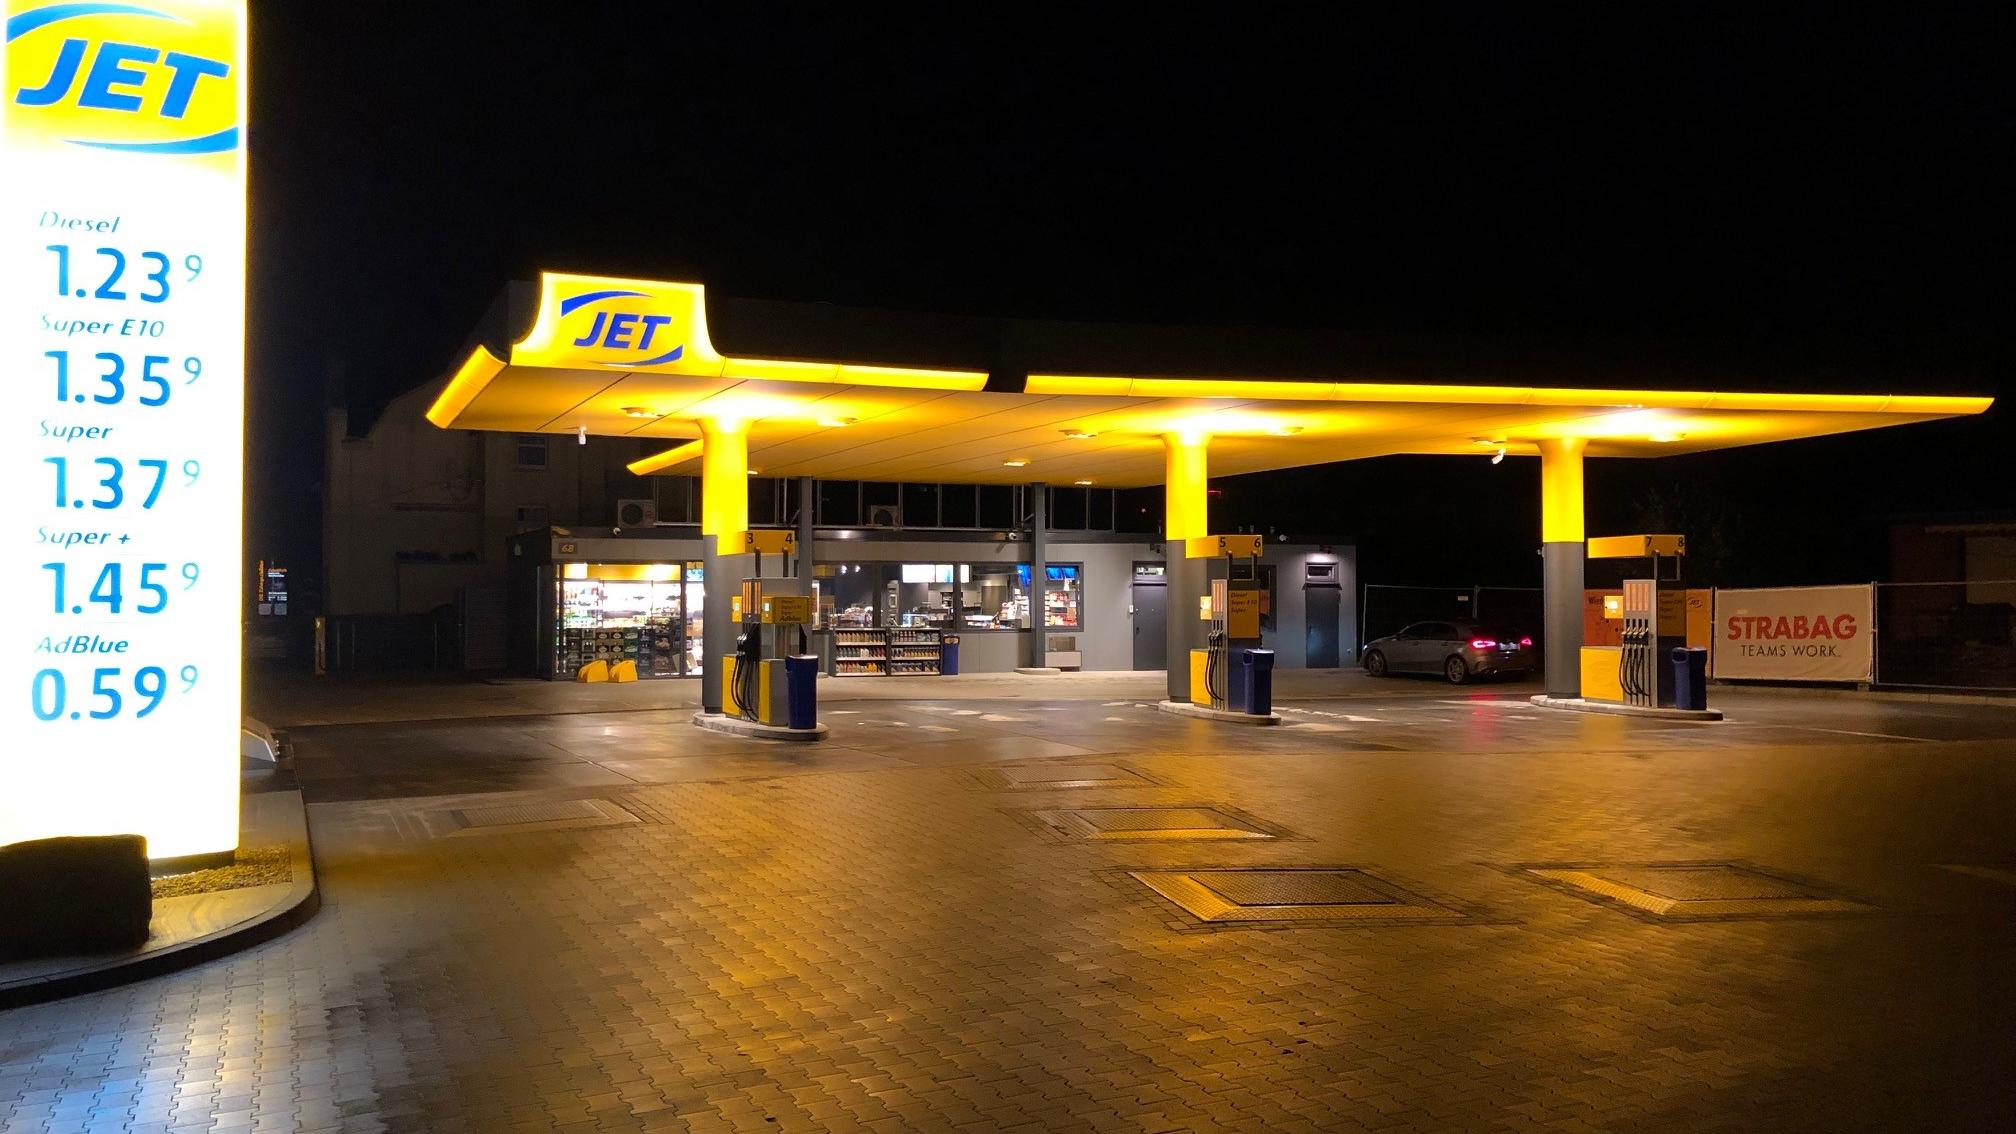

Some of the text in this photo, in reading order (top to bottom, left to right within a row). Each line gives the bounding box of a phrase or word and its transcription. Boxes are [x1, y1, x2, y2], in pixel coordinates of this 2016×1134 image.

[15, 38, 230, 120] JET
[39, 210, 121, 234] Diesel
[40, 313, 165, 338] Super E10
[573, 311, 673, 350] JET
[39, 419, 114, 443] Super
[37, 526, 112, 551] Super
[747, 532, 793, 545] 3 4
[1219, 537, 1261, 548] 5 6
[1678, 537, 1684, 547] 8
[1727, 614, 1857, 641] STRABAG
[34, 634, 129, 654] AdBlue
[1741, 644, 1787, 657] TEAMS
